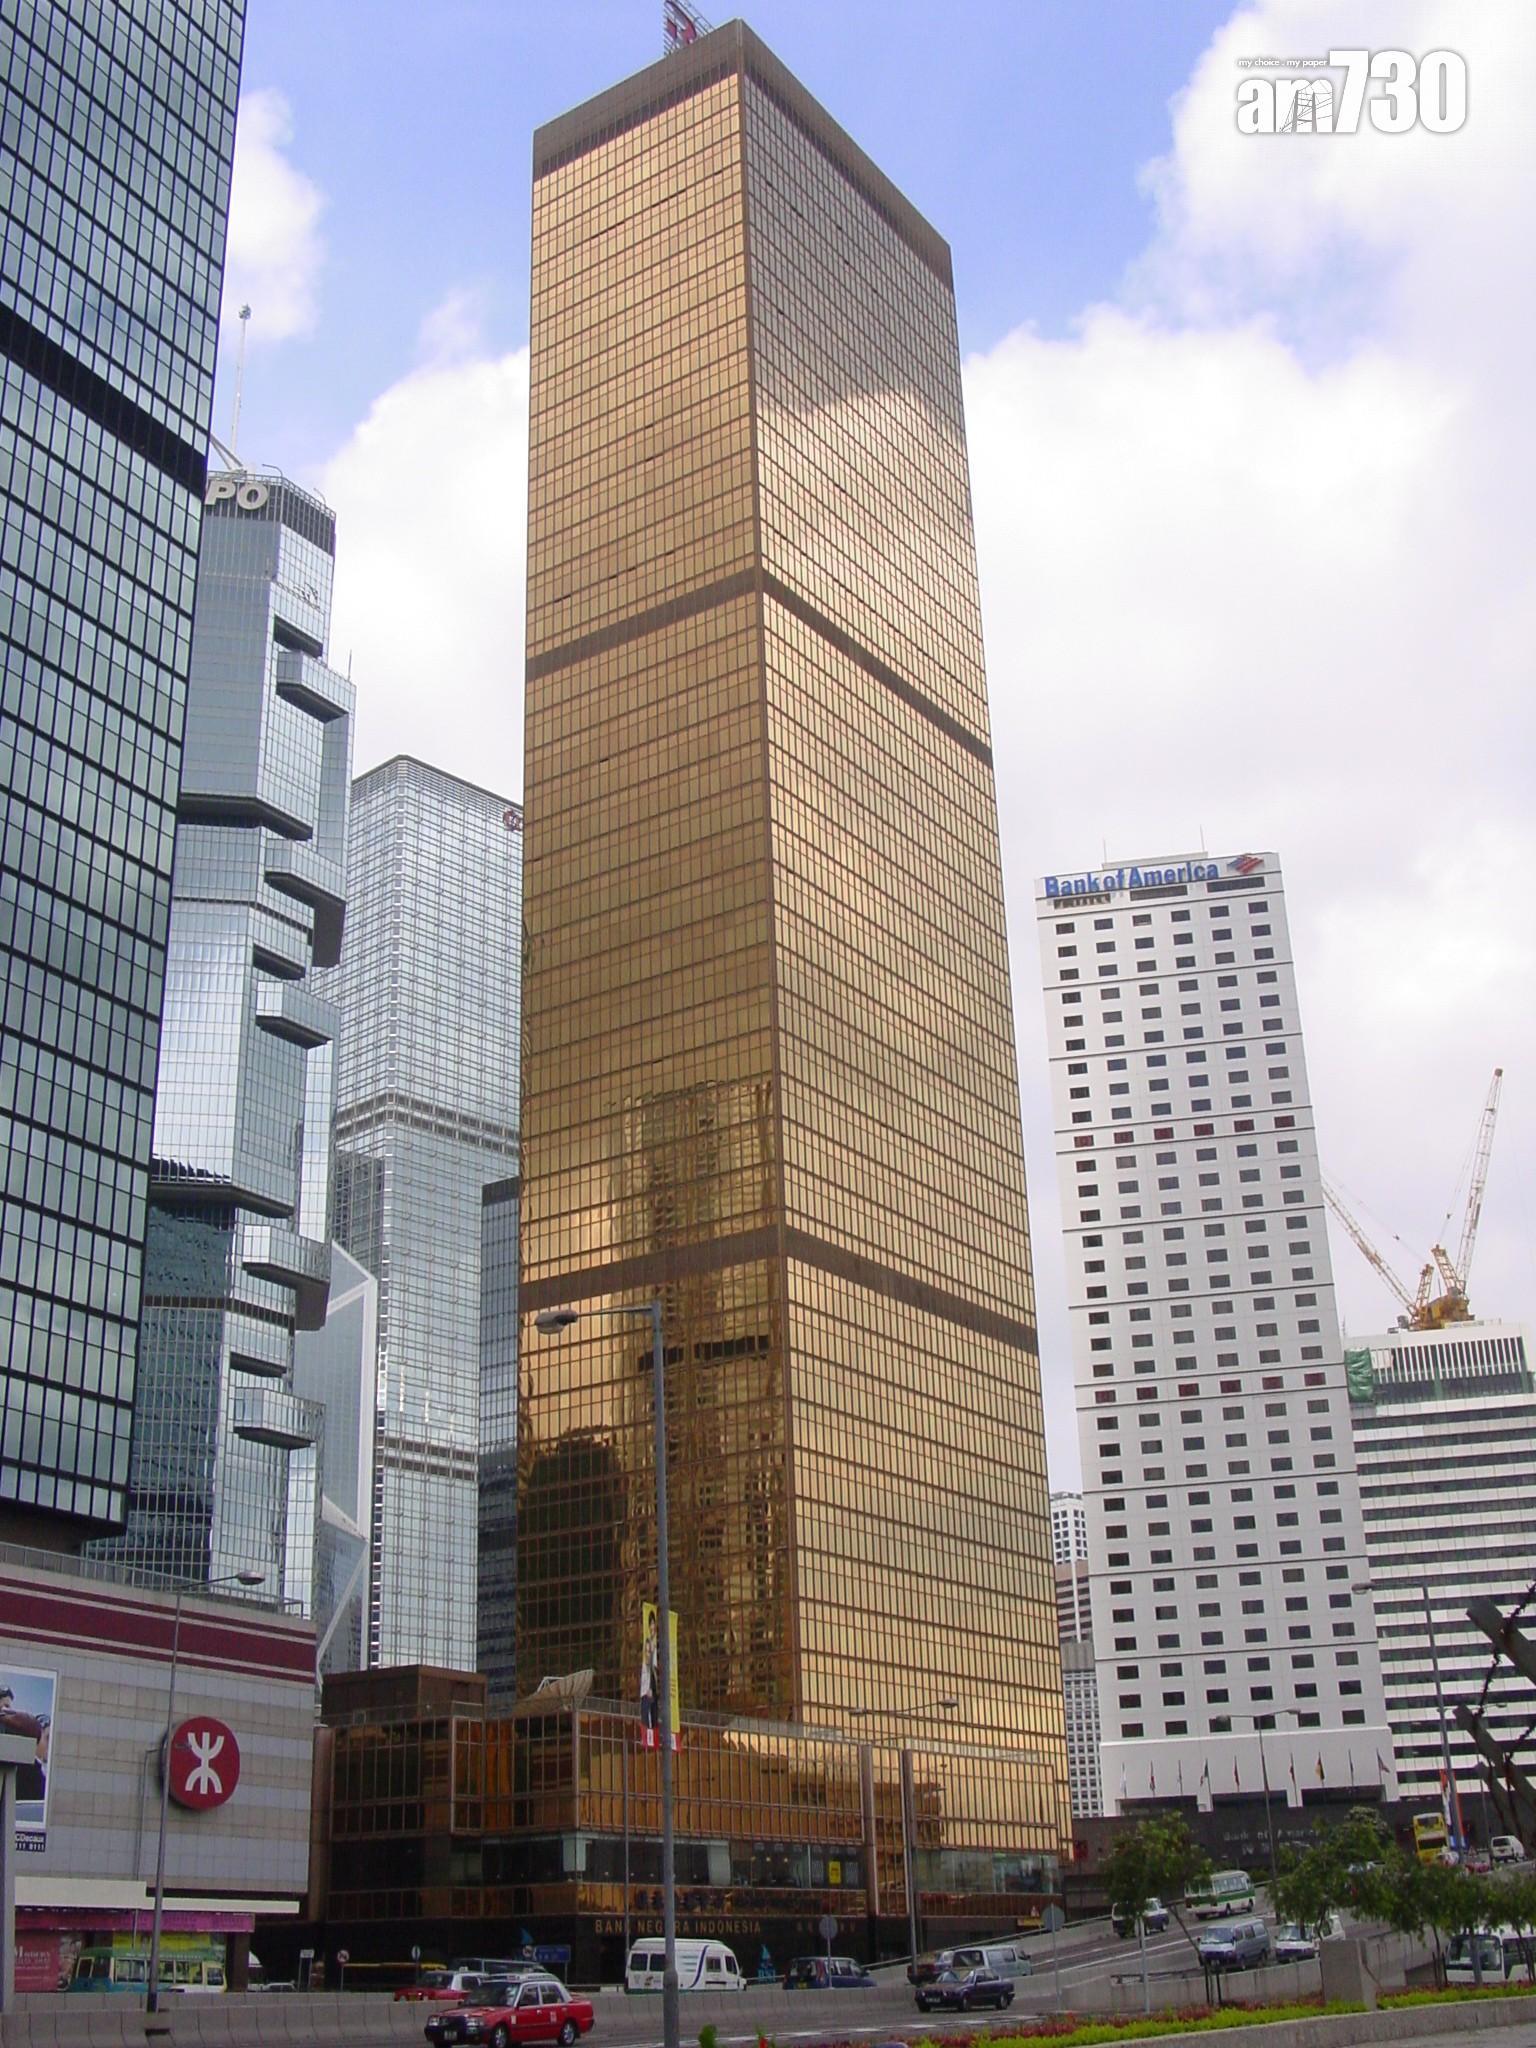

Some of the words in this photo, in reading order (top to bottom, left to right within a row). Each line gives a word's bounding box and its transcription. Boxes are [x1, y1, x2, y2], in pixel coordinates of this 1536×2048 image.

[1045, 872, 1101, 898] Bank
[1104, 869, 1124, 890] of
[1129, 862, 1219, 888] America
[595, 1919, 632, 1934] BAN
[637, 1919, 690, 1934] NEGRA
[695, 1919, 761, 1934] INDONESIA
